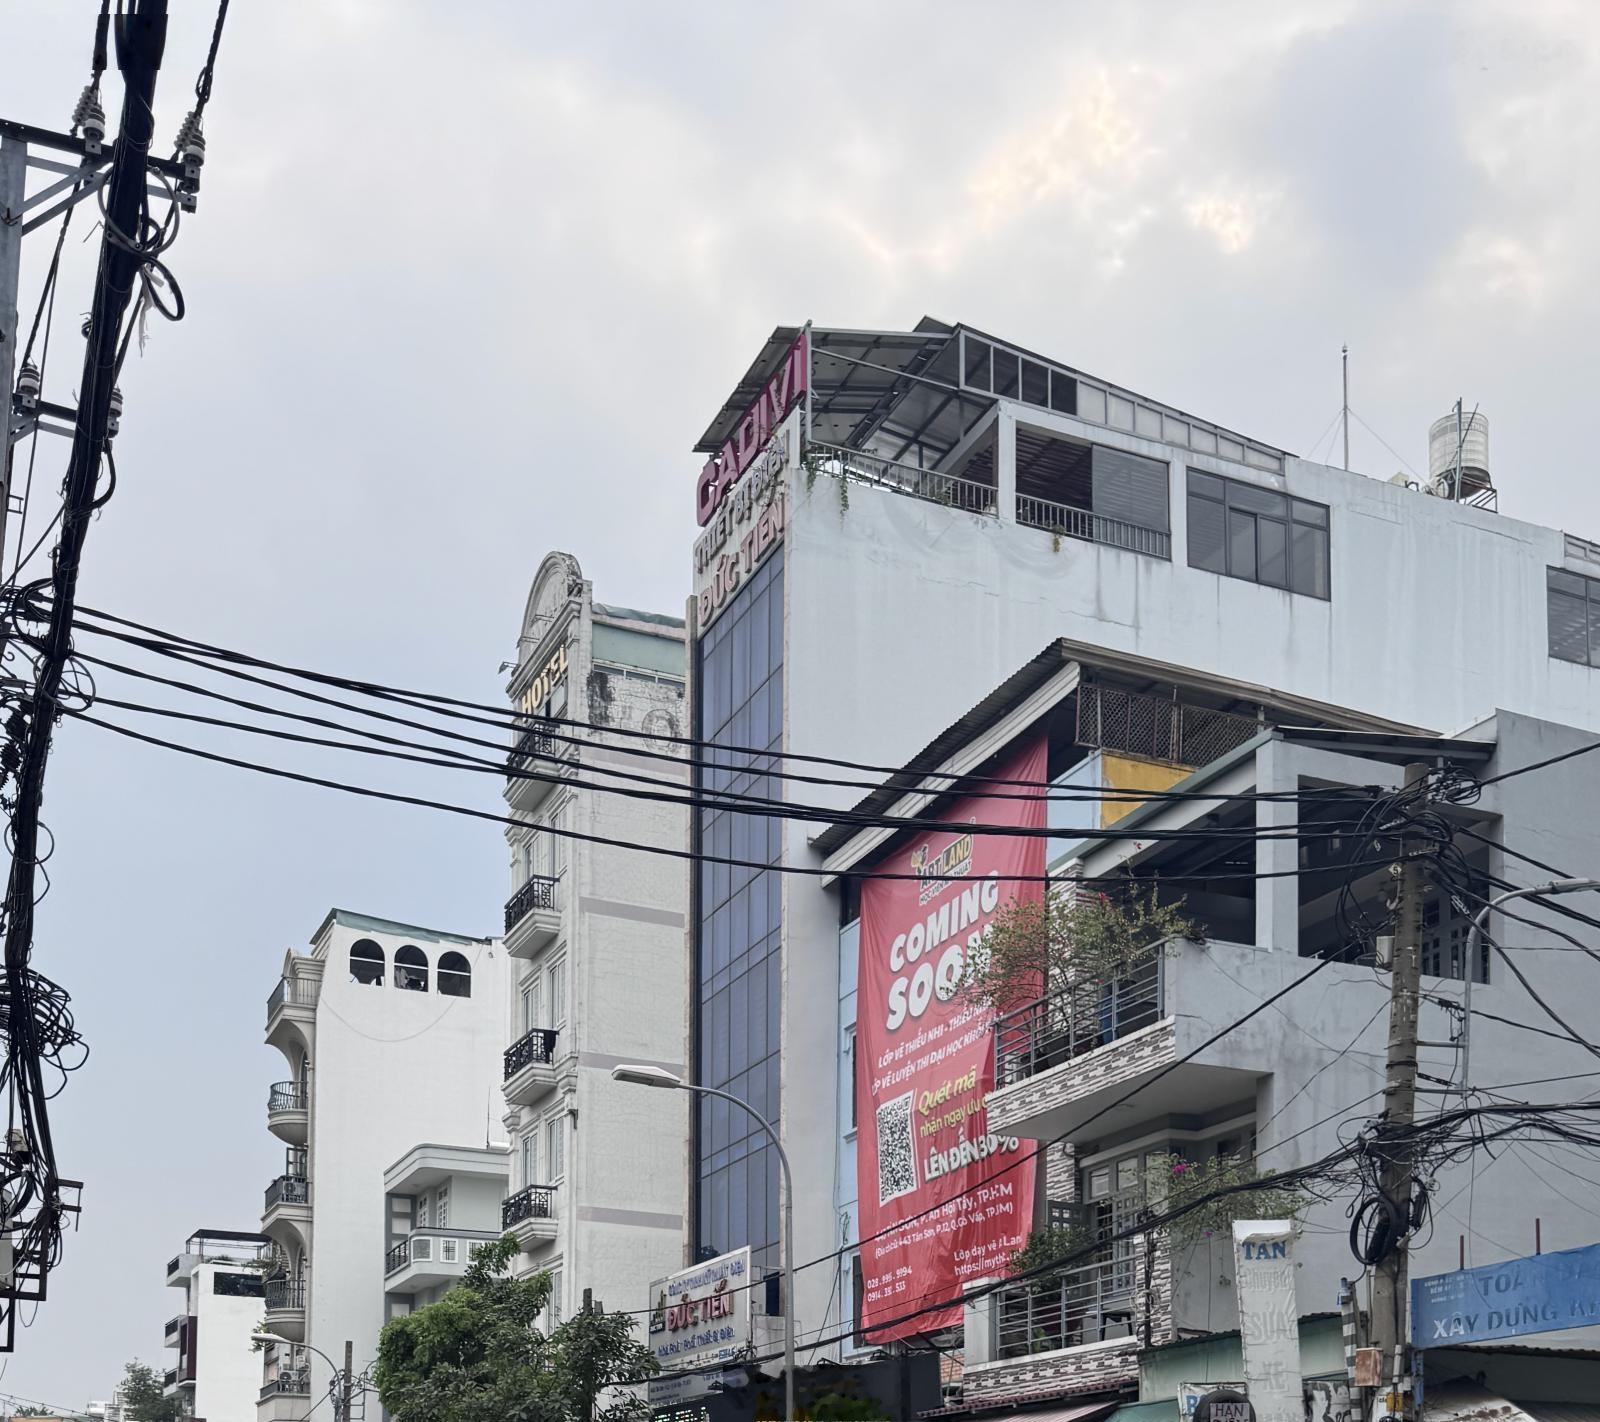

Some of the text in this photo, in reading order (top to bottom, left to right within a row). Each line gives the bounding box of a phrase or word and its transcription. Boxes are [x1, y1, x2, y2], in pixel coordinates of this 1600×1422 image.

[696, 333, 807, 527] CADIVI
[700, 552, 740, 627] ĐỨC
[521, 644, 568, 723] HOTEL
[889, 870, 999, 973] COMING
[927, 1023, 944, 1042] NHI
[917, 1081, 951, 1117] Quét
[953, 1064, 978, 1094] mã
[924, 1147, 950, 1183] LÊN
[667, 1279, 735, 1332] ĐỨC TIẾN
[1433, 1312, 1479, 1339] XÂY
